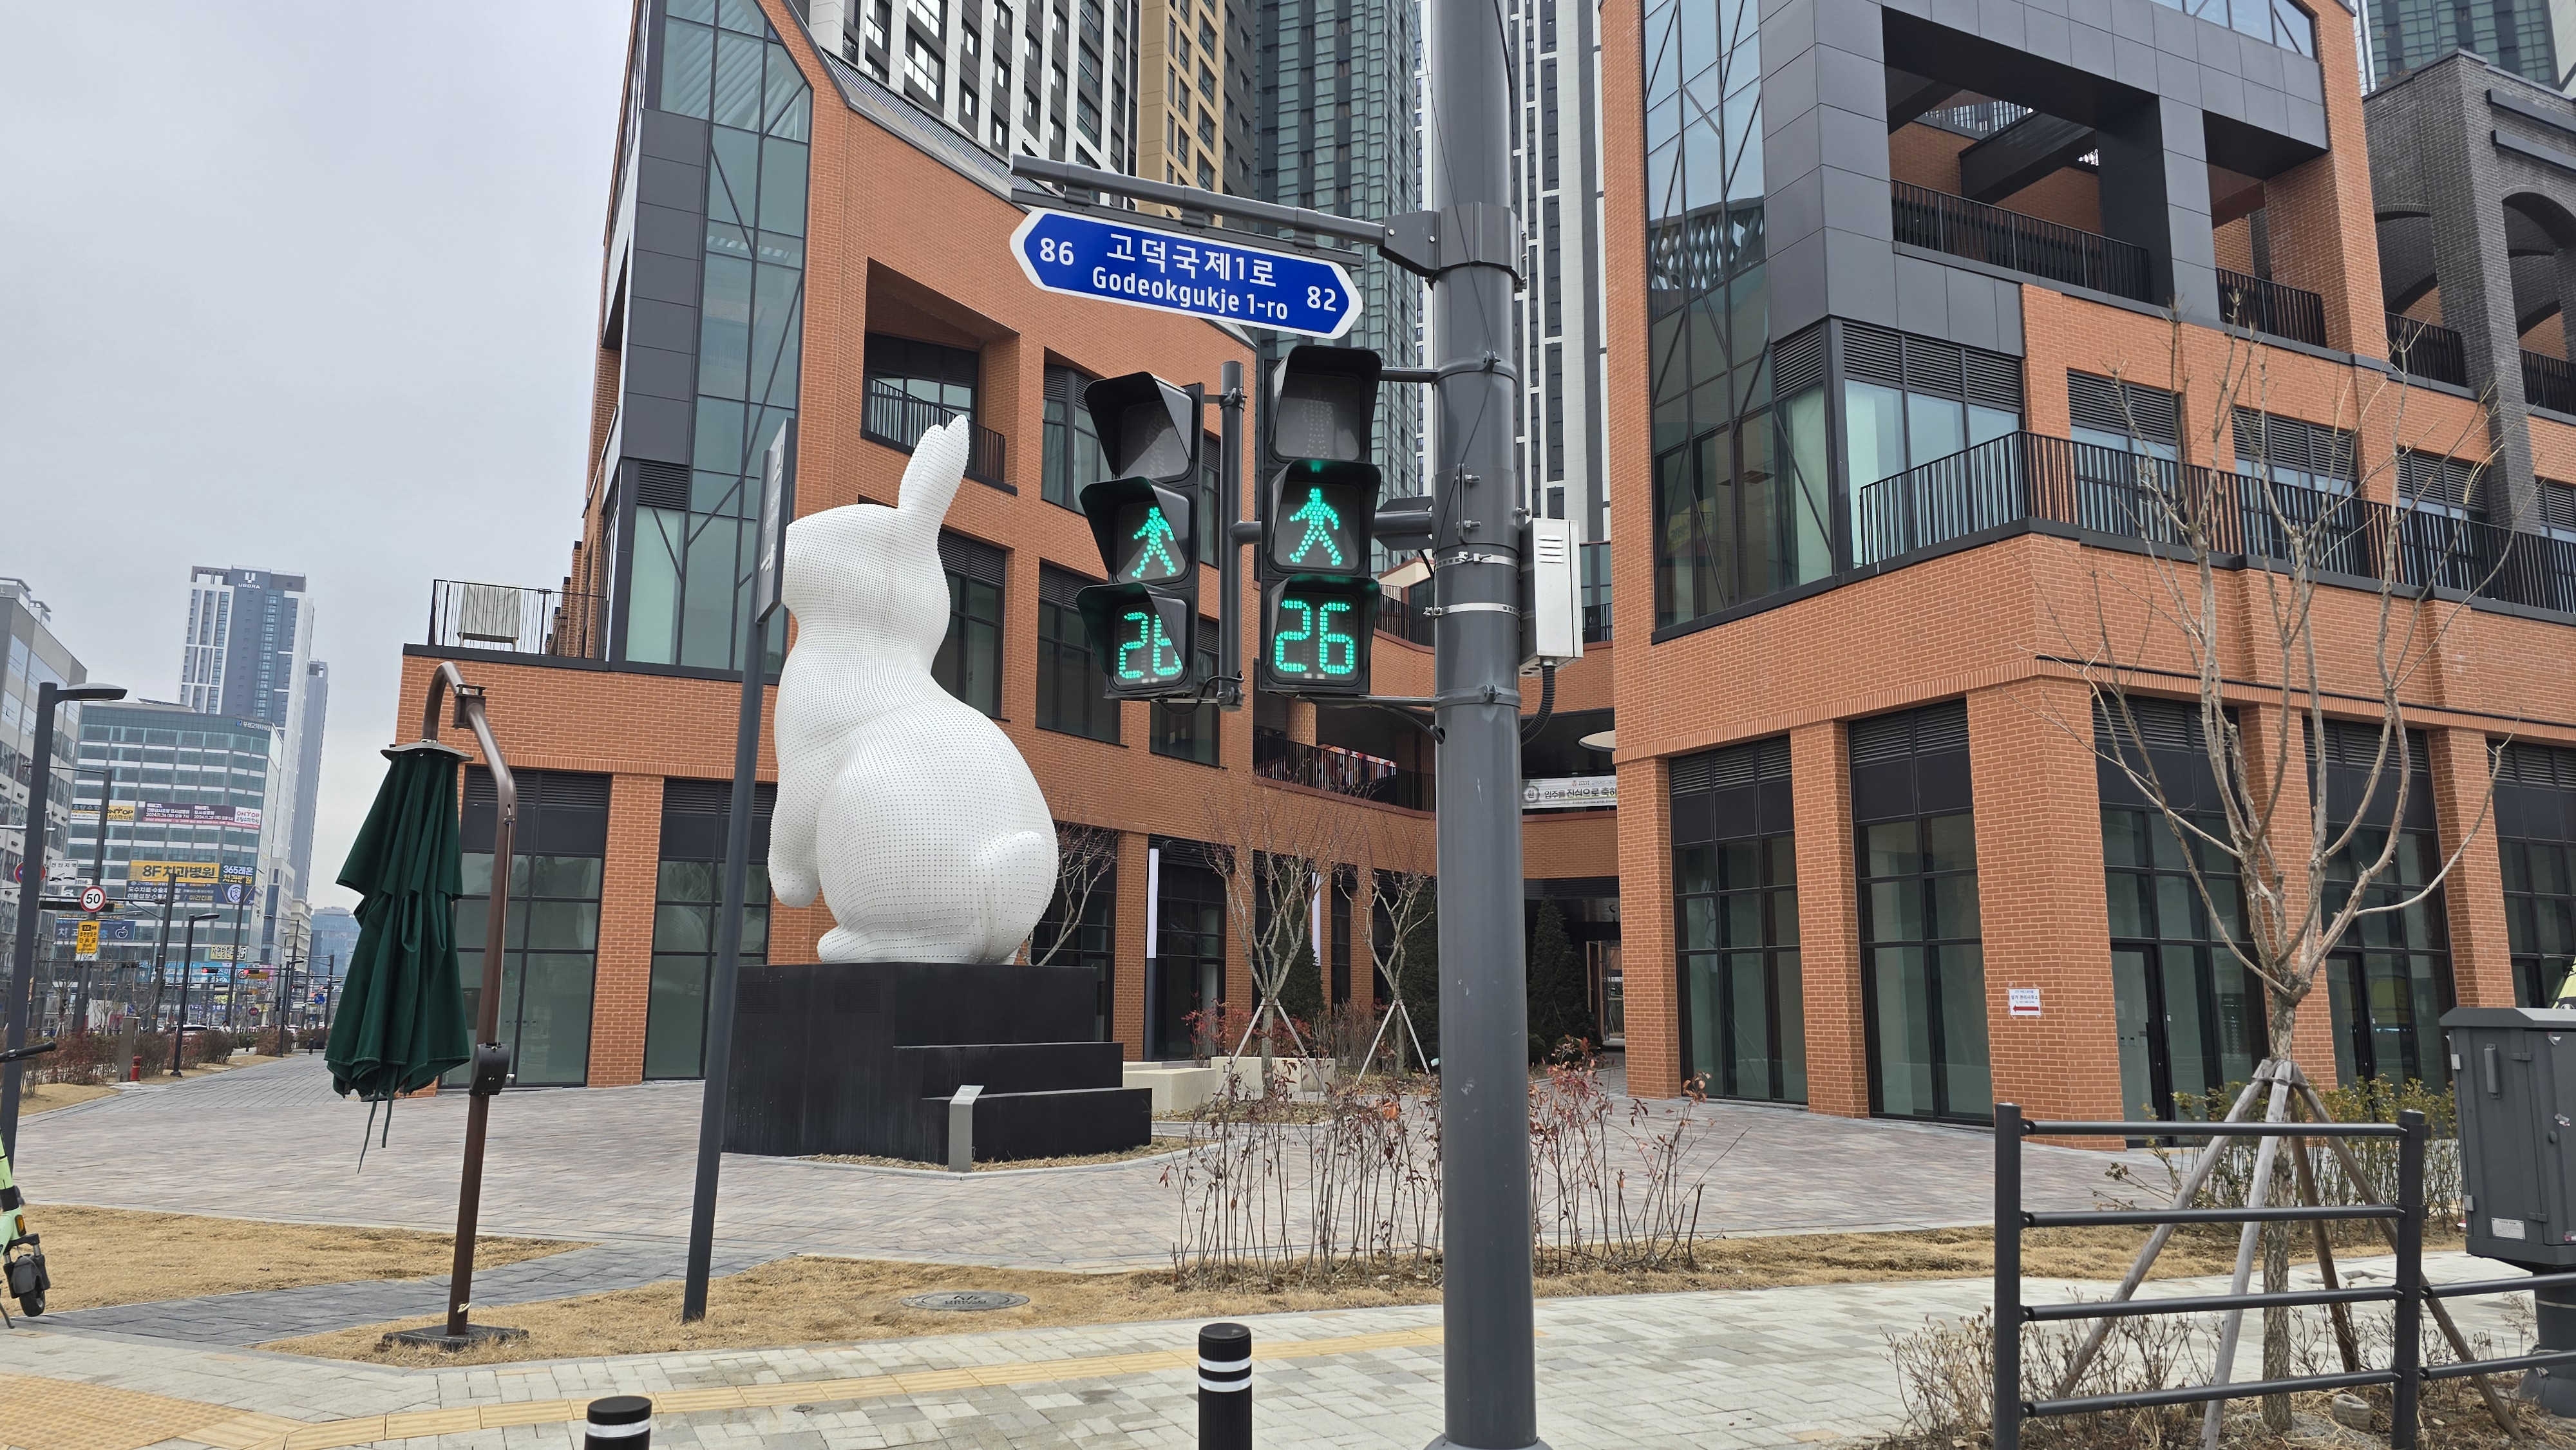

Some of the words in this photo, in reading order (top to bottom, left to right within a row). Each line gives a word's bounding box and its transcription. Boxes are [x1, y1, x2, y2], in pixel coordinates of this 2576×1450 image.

[1039, 238, 1074, 266] 86
[1106, 232, 1276, 288] 고덕국제1로
[1092, 267, 1240, 314] Godeokgukje
[1246, 293, 1288, 320] 1-ro
[1306, 286, 1337, 312] 82
[1274, 599, 1355, 675] 26
[1544, 789, 1566, 799] 입주를
[1566, 788, 1600, 798] 진심으로
[86, 893, 100, 904] 50
